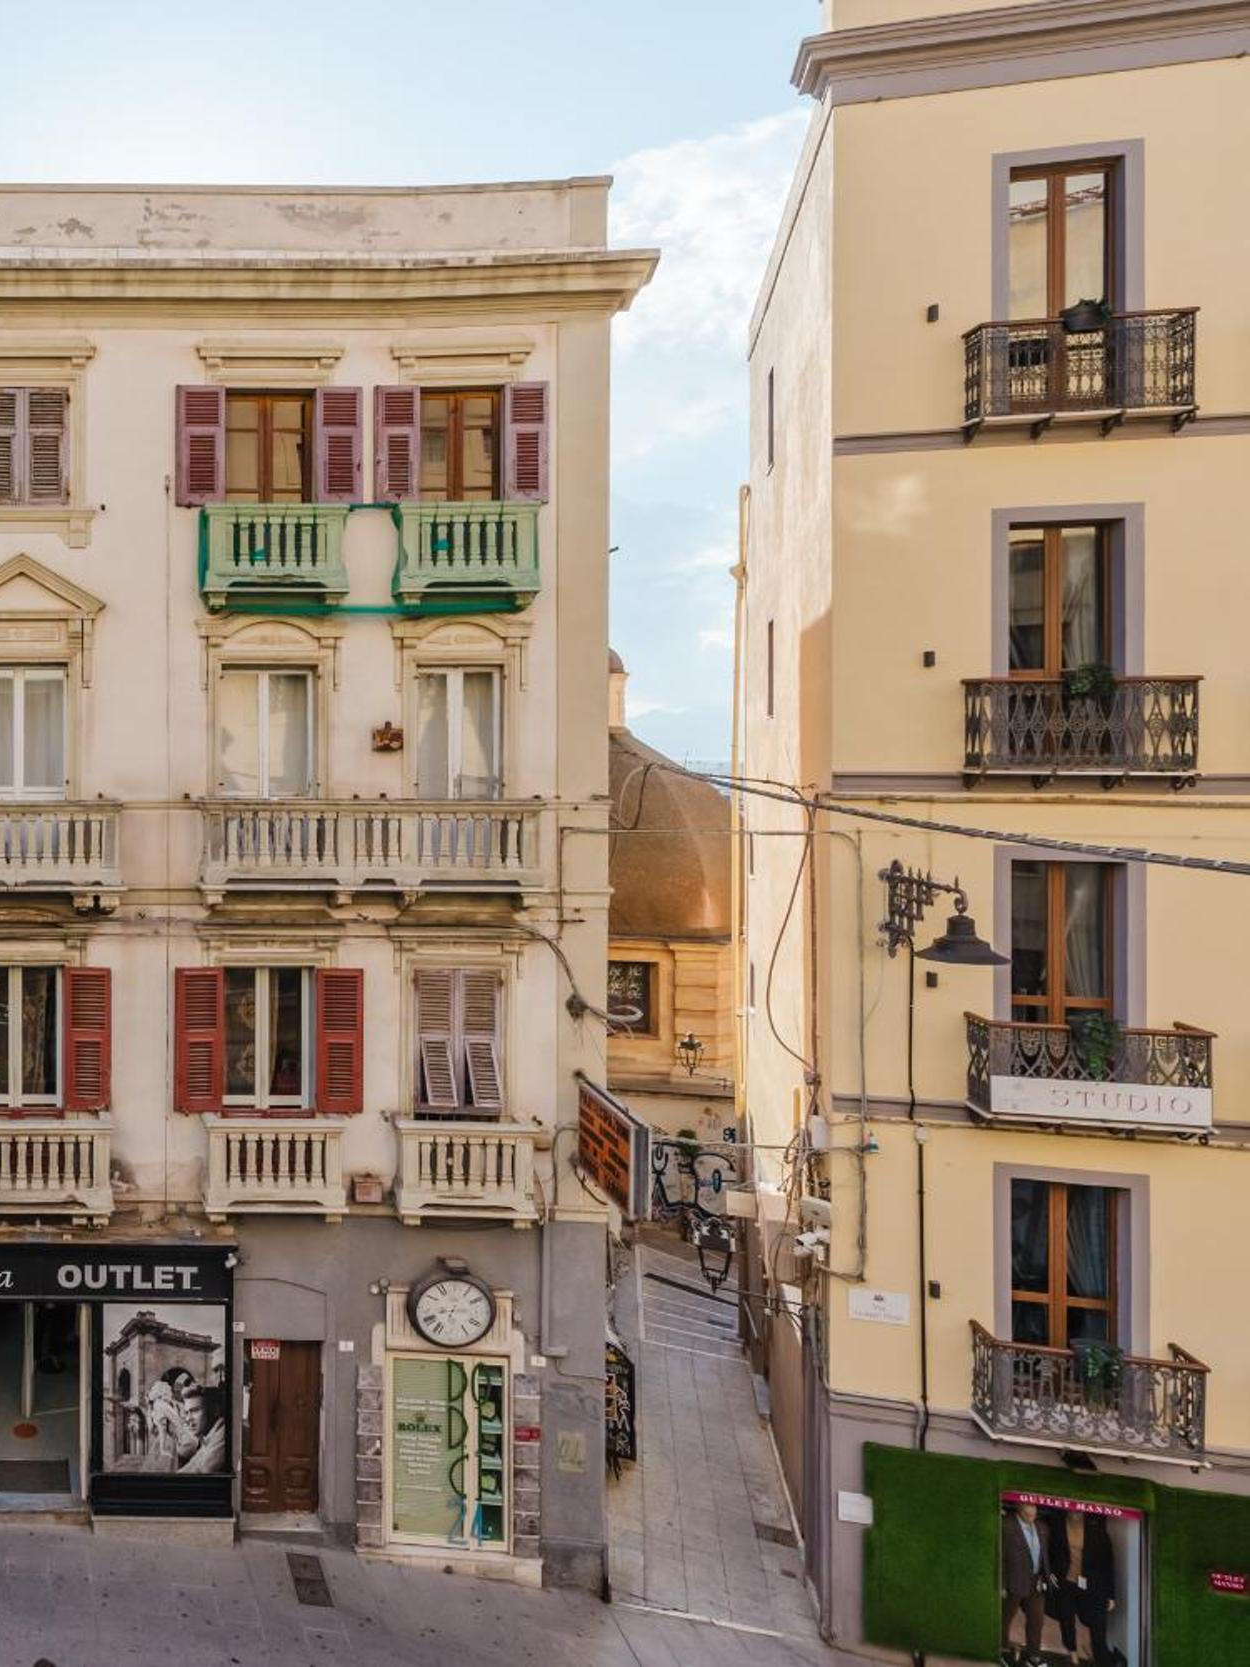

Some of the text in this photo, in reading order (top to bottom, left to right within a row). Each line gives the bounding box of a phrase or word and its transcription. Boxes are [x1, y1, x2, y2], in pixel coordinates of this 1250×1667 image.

[1049, 1086, 1193, 1115] STUDIO
[57, 1265, 199, 1290] OUTLET
[397, 1422, 443, 1433] ROLEX
[1019, 1494, 1123, 1517] OUTLET MANNO
